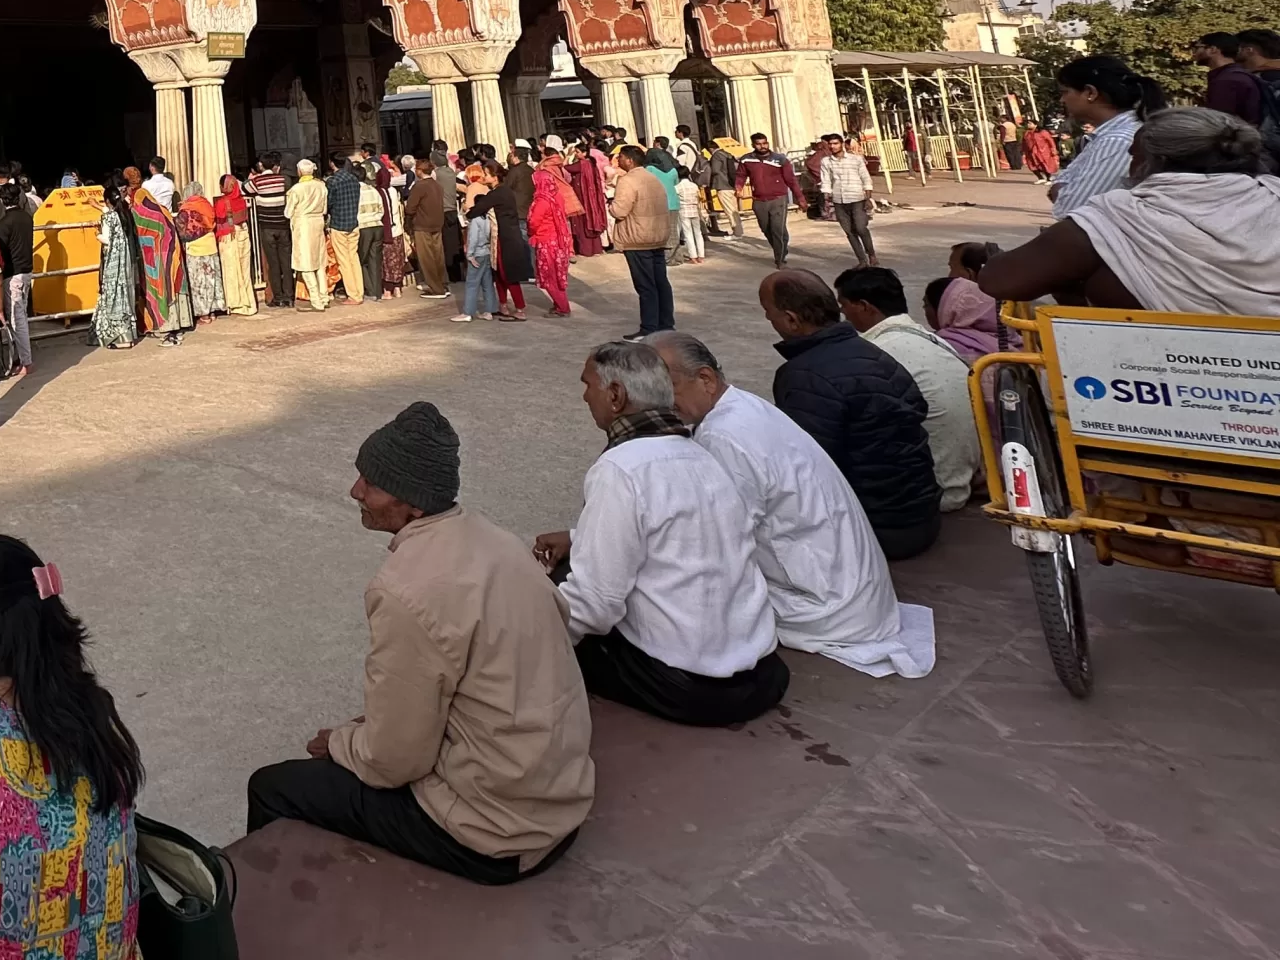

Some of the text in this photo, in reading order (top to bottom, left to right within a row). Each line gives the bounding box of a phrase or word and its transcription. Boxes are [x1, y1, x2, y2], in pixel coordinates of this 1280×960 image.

[1166, 353, 1242, 368] DONATED
[1119, 363, 1167, 373] Corporate
[1170, 367, 1200, 376] Social
[1110, 379, 1173, 406] SBI
[1180, 400, 1274, 416] Service Beyond
[1081, 420, 1116, 432] SHREE
[1117, 424, 1173, 438] BHAGWAN
[1174, 429, 1237, 444] MAHAVEER
[1221, 422, 1279, 436] THROUGH
